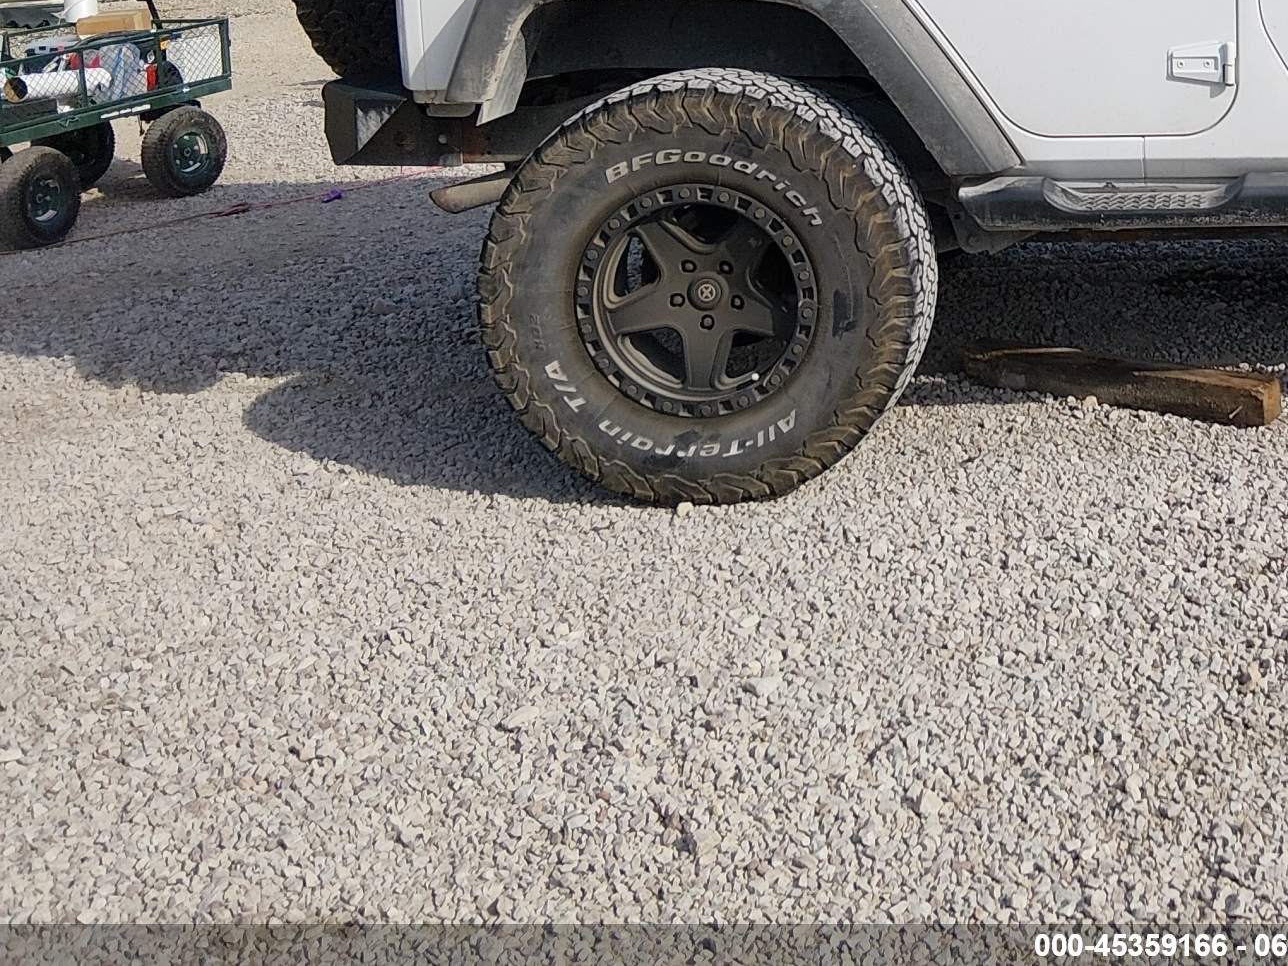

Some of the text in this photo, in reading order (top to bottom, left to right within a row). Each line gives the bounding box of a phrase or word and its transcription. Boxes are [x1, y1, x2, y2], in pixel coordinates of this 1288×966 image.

[604, 148, 823, 227] BFGoodrich
[544, 360, 798, 459] All-Terrain T/A
